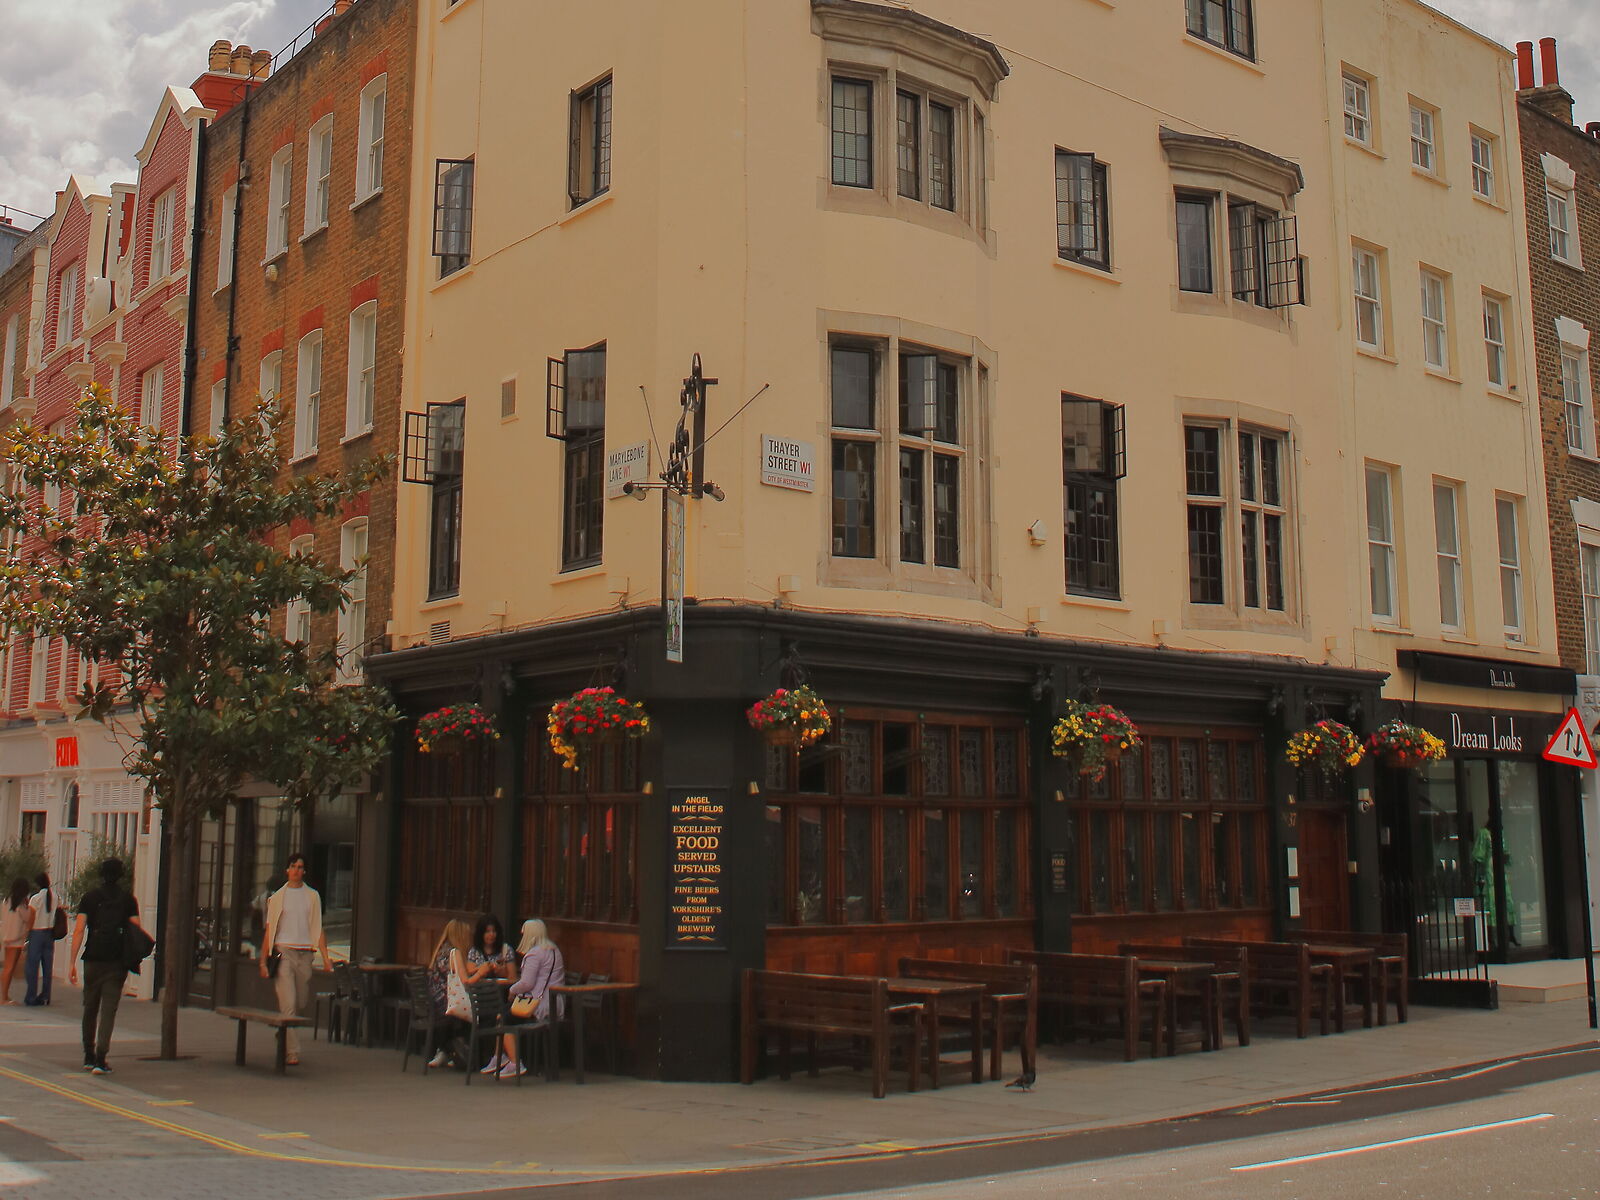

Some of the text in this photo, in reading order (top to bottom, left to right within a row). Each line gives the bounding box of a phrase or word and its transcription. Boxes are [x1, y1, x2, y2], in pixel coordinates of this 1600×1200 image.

[768, 439, 800, 458] THAYER
[609, 445, 645, 466] MARYLEBONE
[768, 455, 811, 475] STREET W1
[609, 467, 622, 482] LANE
[767, 475, 777, 483] CITY
[782, 477, 809, 488] WESTMINSTER
[1450, 712, 1522, 752] Dream Looks
[685, 796, 710, 804] ANGEL
[682, 805, 696, 813] THE
[698, 805, 723, 813] FIELDS
[673, 825, 722, 834] EXCELLENT
[676, 836, 718, 849] FOOD
[678, 852, 716, 861] SERVED
[674, 864, 720, 873] UPSTAIRS
[674, 886, 719, 894] FINE BEERS
[686, 896, 706, 904] FROM
[672, 905, 721, 913] YORKSHIRE'S
[681, 915, 710, 923] OLDEST
[677, 925, 715, 933] BREWERY
